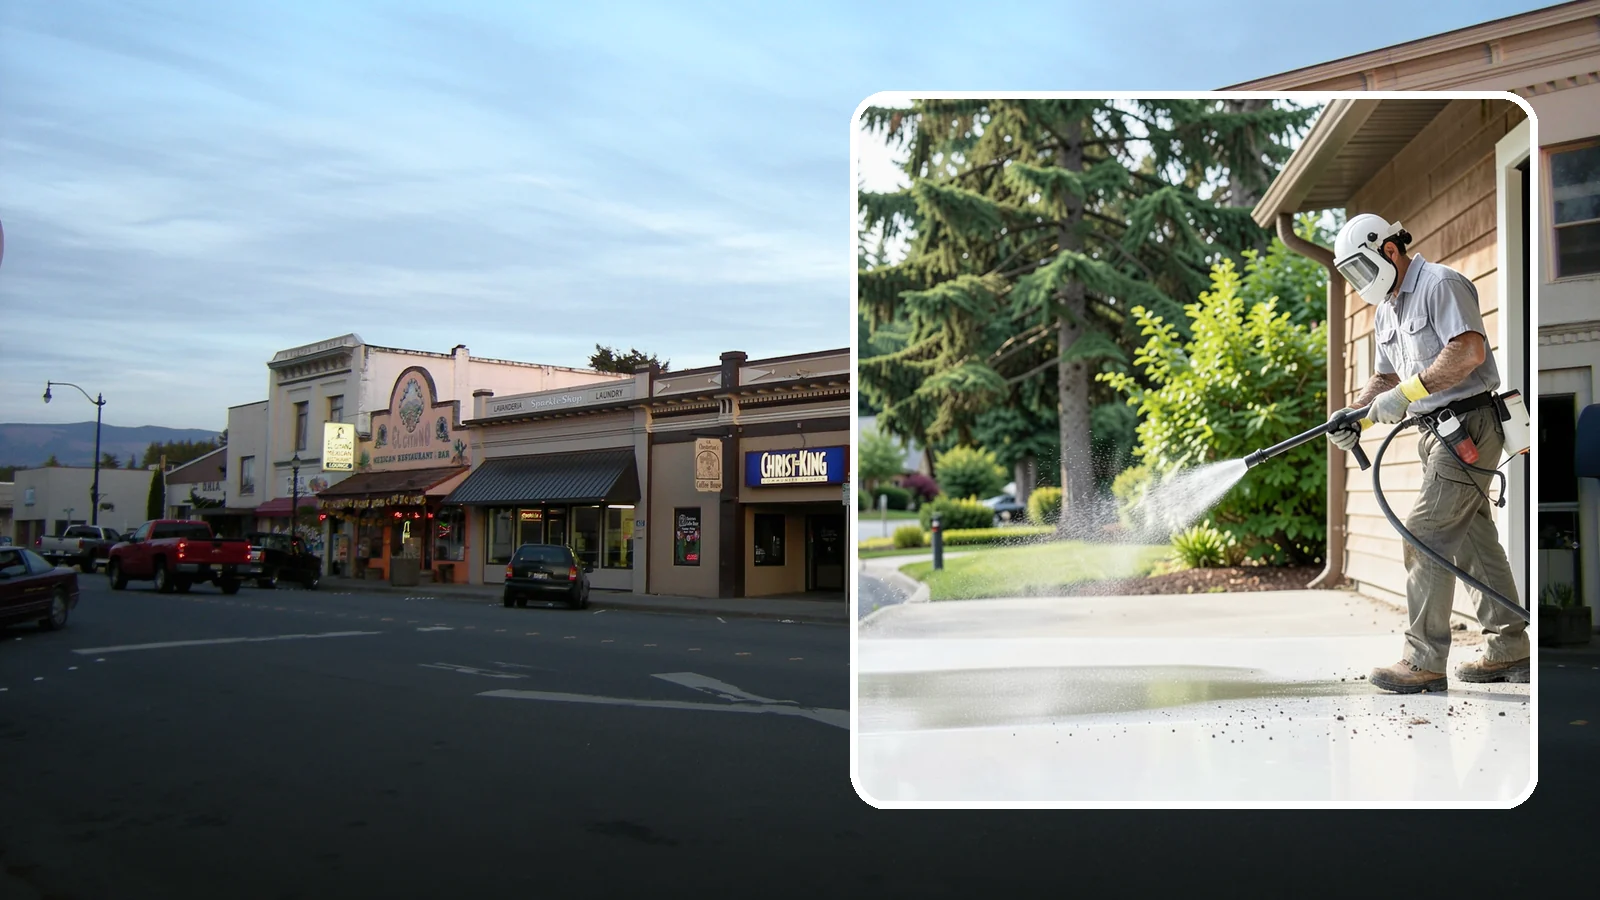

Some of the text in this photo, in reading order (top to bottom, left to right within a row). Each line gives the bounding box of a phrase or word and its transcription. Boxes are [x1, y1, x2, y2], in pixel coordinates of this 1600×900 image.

[562, 394, 582, 404] Shop
[596, 389, 624, 400] LAUNDRY
[494, 402, 522, 412] LAVANDERIA
[374, 450, 450, 464] MEXICAN RESTAURANT BAR
[760, 450, 827, 478] CHRIST KING
